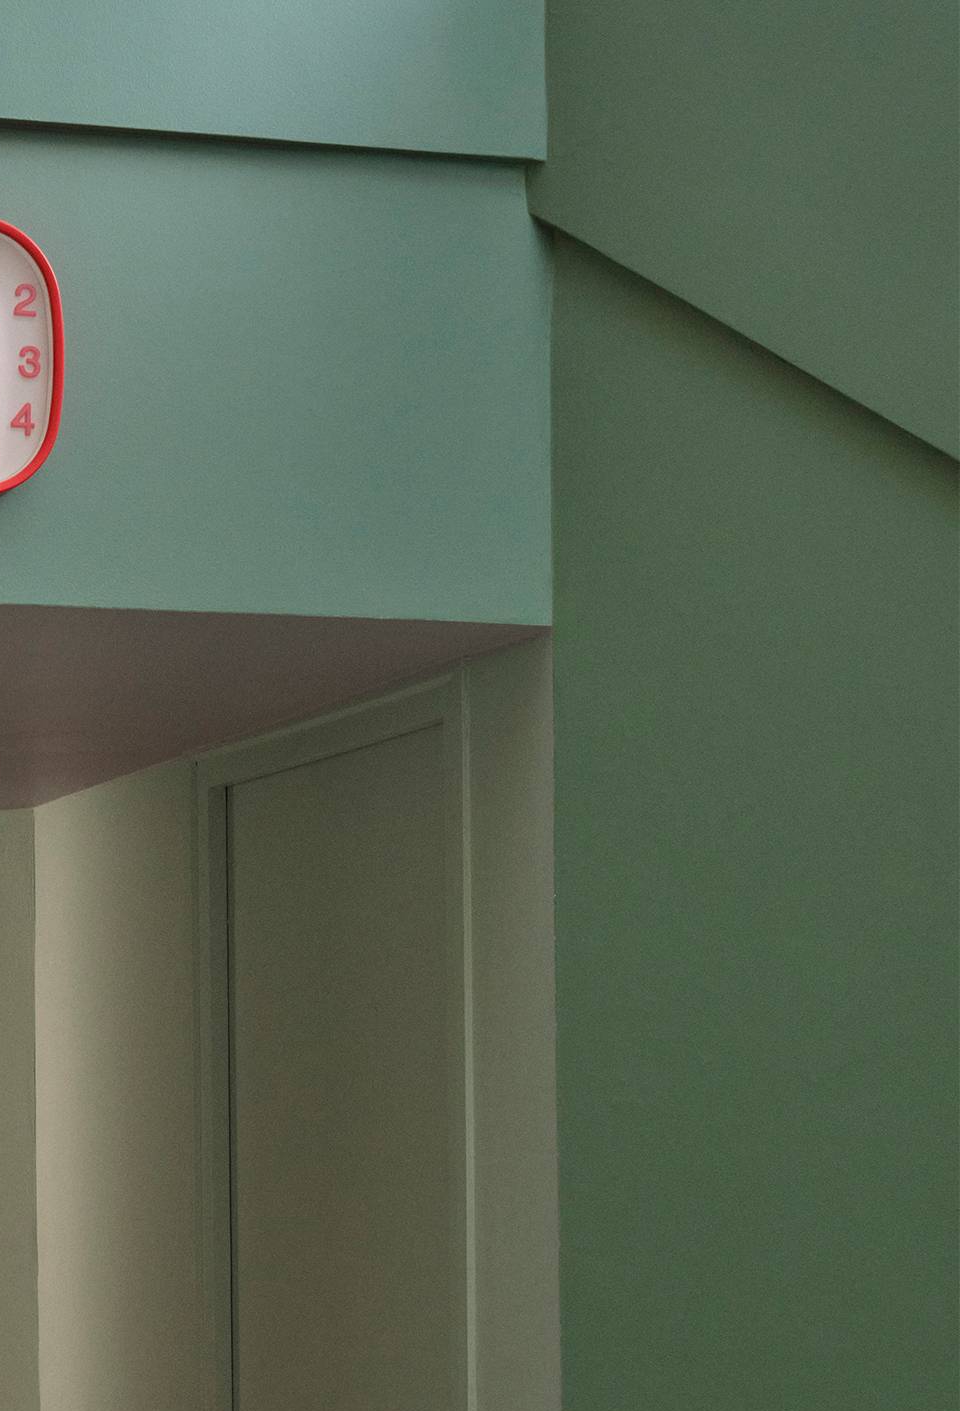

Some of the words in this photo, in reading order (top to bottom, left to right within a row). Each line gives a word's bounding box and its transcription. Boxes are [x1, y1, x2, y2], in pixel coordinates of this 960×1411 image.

[14, 284, 37, 317] 2
[18, 346, 41, 379] 3
[11, 403, 35, 436] 4
